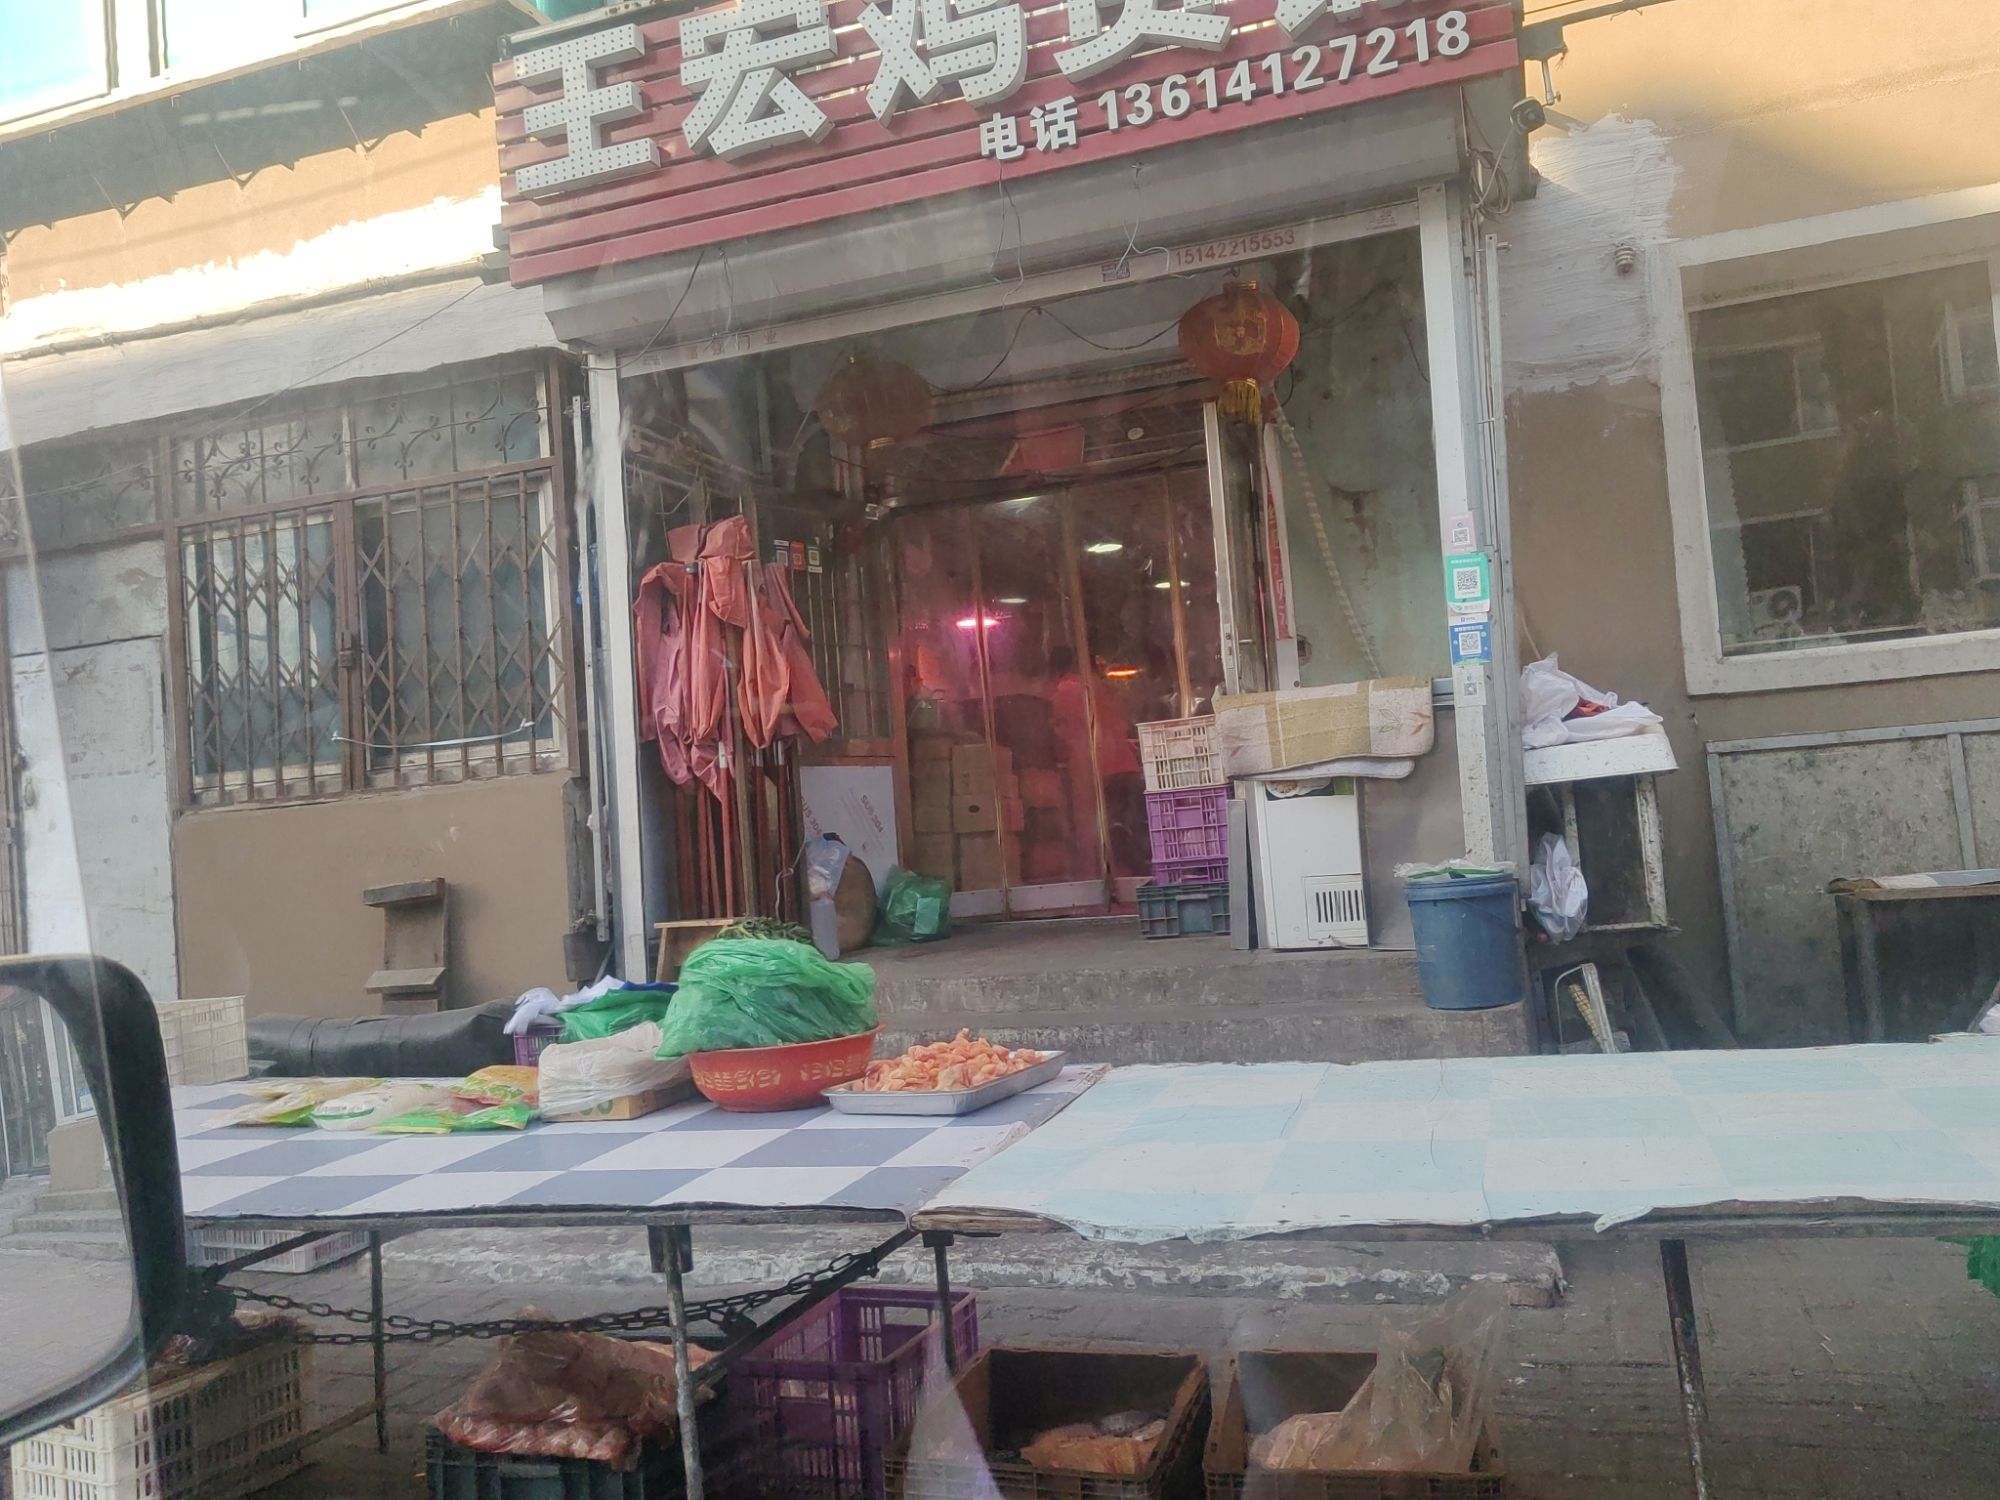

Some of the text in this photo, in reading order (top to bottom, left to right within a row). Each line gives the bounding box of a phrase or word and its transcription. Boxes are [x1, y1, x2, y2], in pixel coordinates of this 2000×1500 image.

[513, 0, 1402, 196] 王宏鸡
[980, 10, 1470, 159] 电话 13614127218
[1175, 228, 1296, 266] 15142215553
